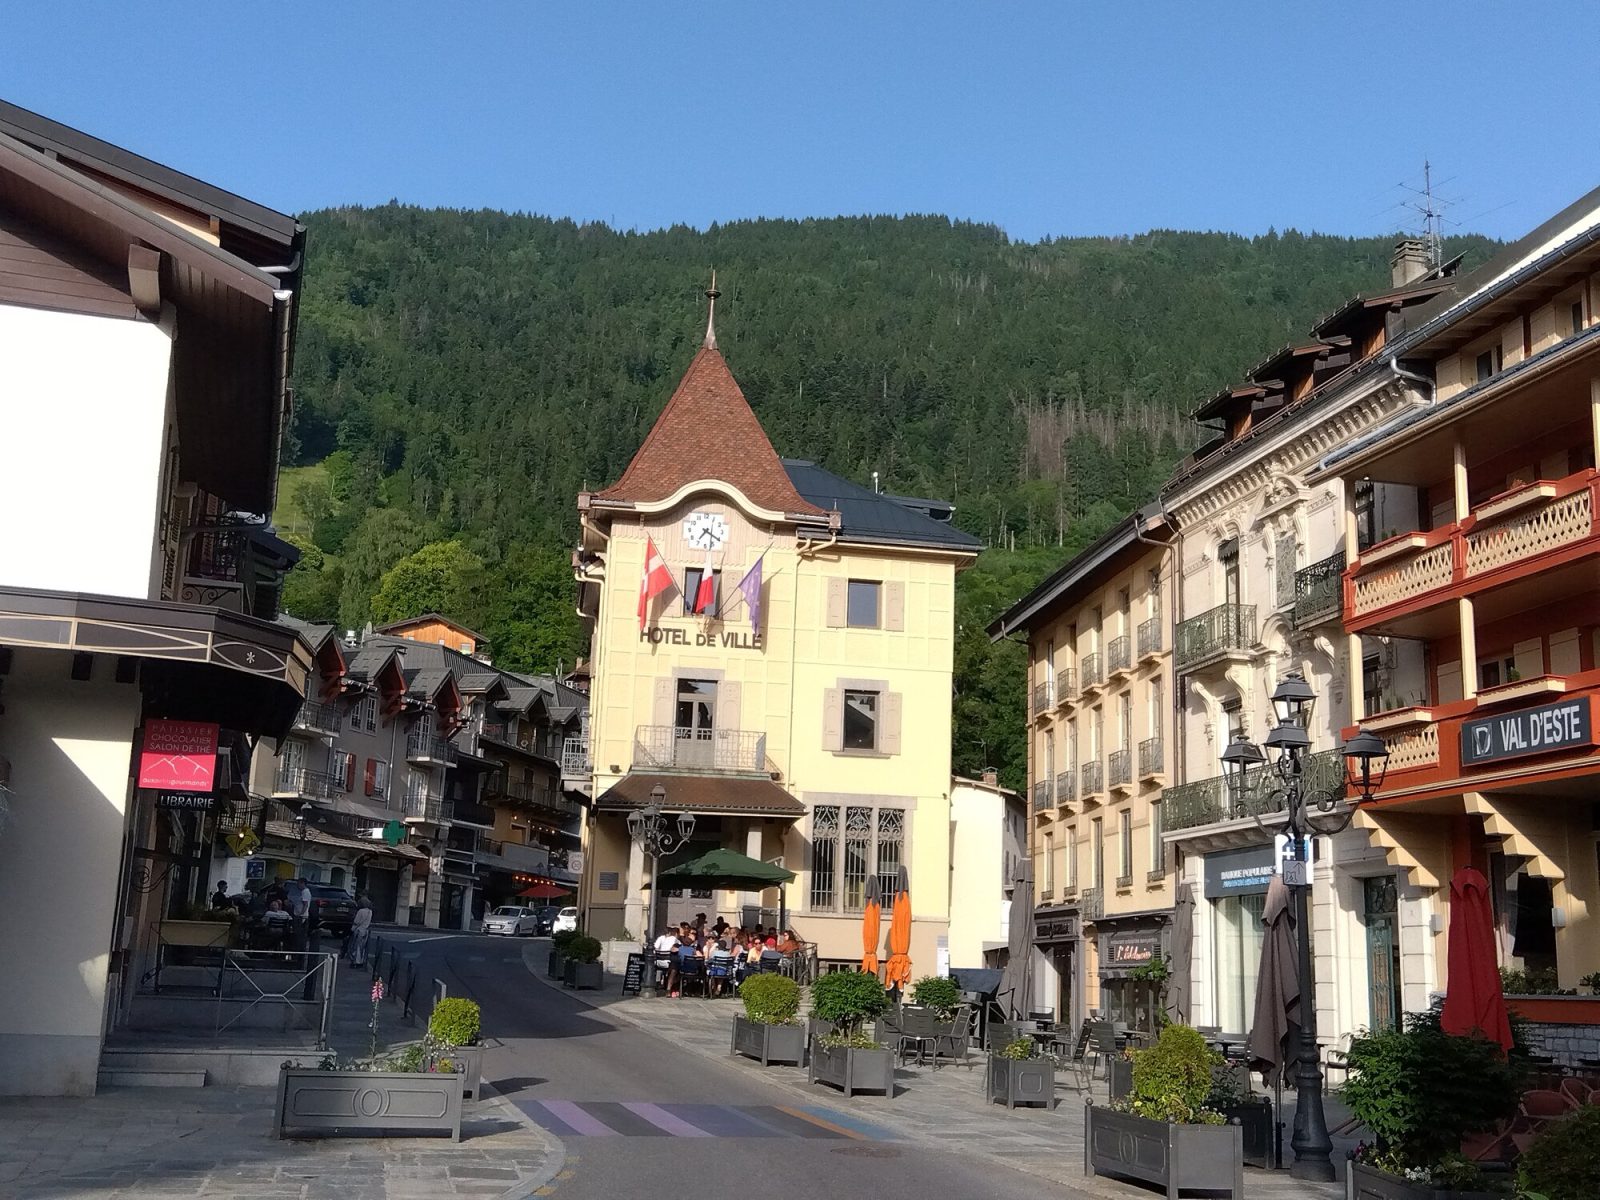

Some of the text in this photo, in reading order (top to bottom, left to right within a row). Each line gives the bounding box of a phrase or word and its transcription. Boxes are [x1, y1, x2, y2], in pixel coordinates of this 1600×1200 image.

[639, 626, 762, 650] HOTEL DE VILLE
[1500, 717, 1527, 751] VAL
[1530, 705, 1581, 746] D'ESTE
[151, 733, 211, 744] CHOCOLATIER
[150, 742, 180, 751] SALON
[182, 744, 193, 752] DE
[160, 795, 214, 808] LIBRAIRIE
